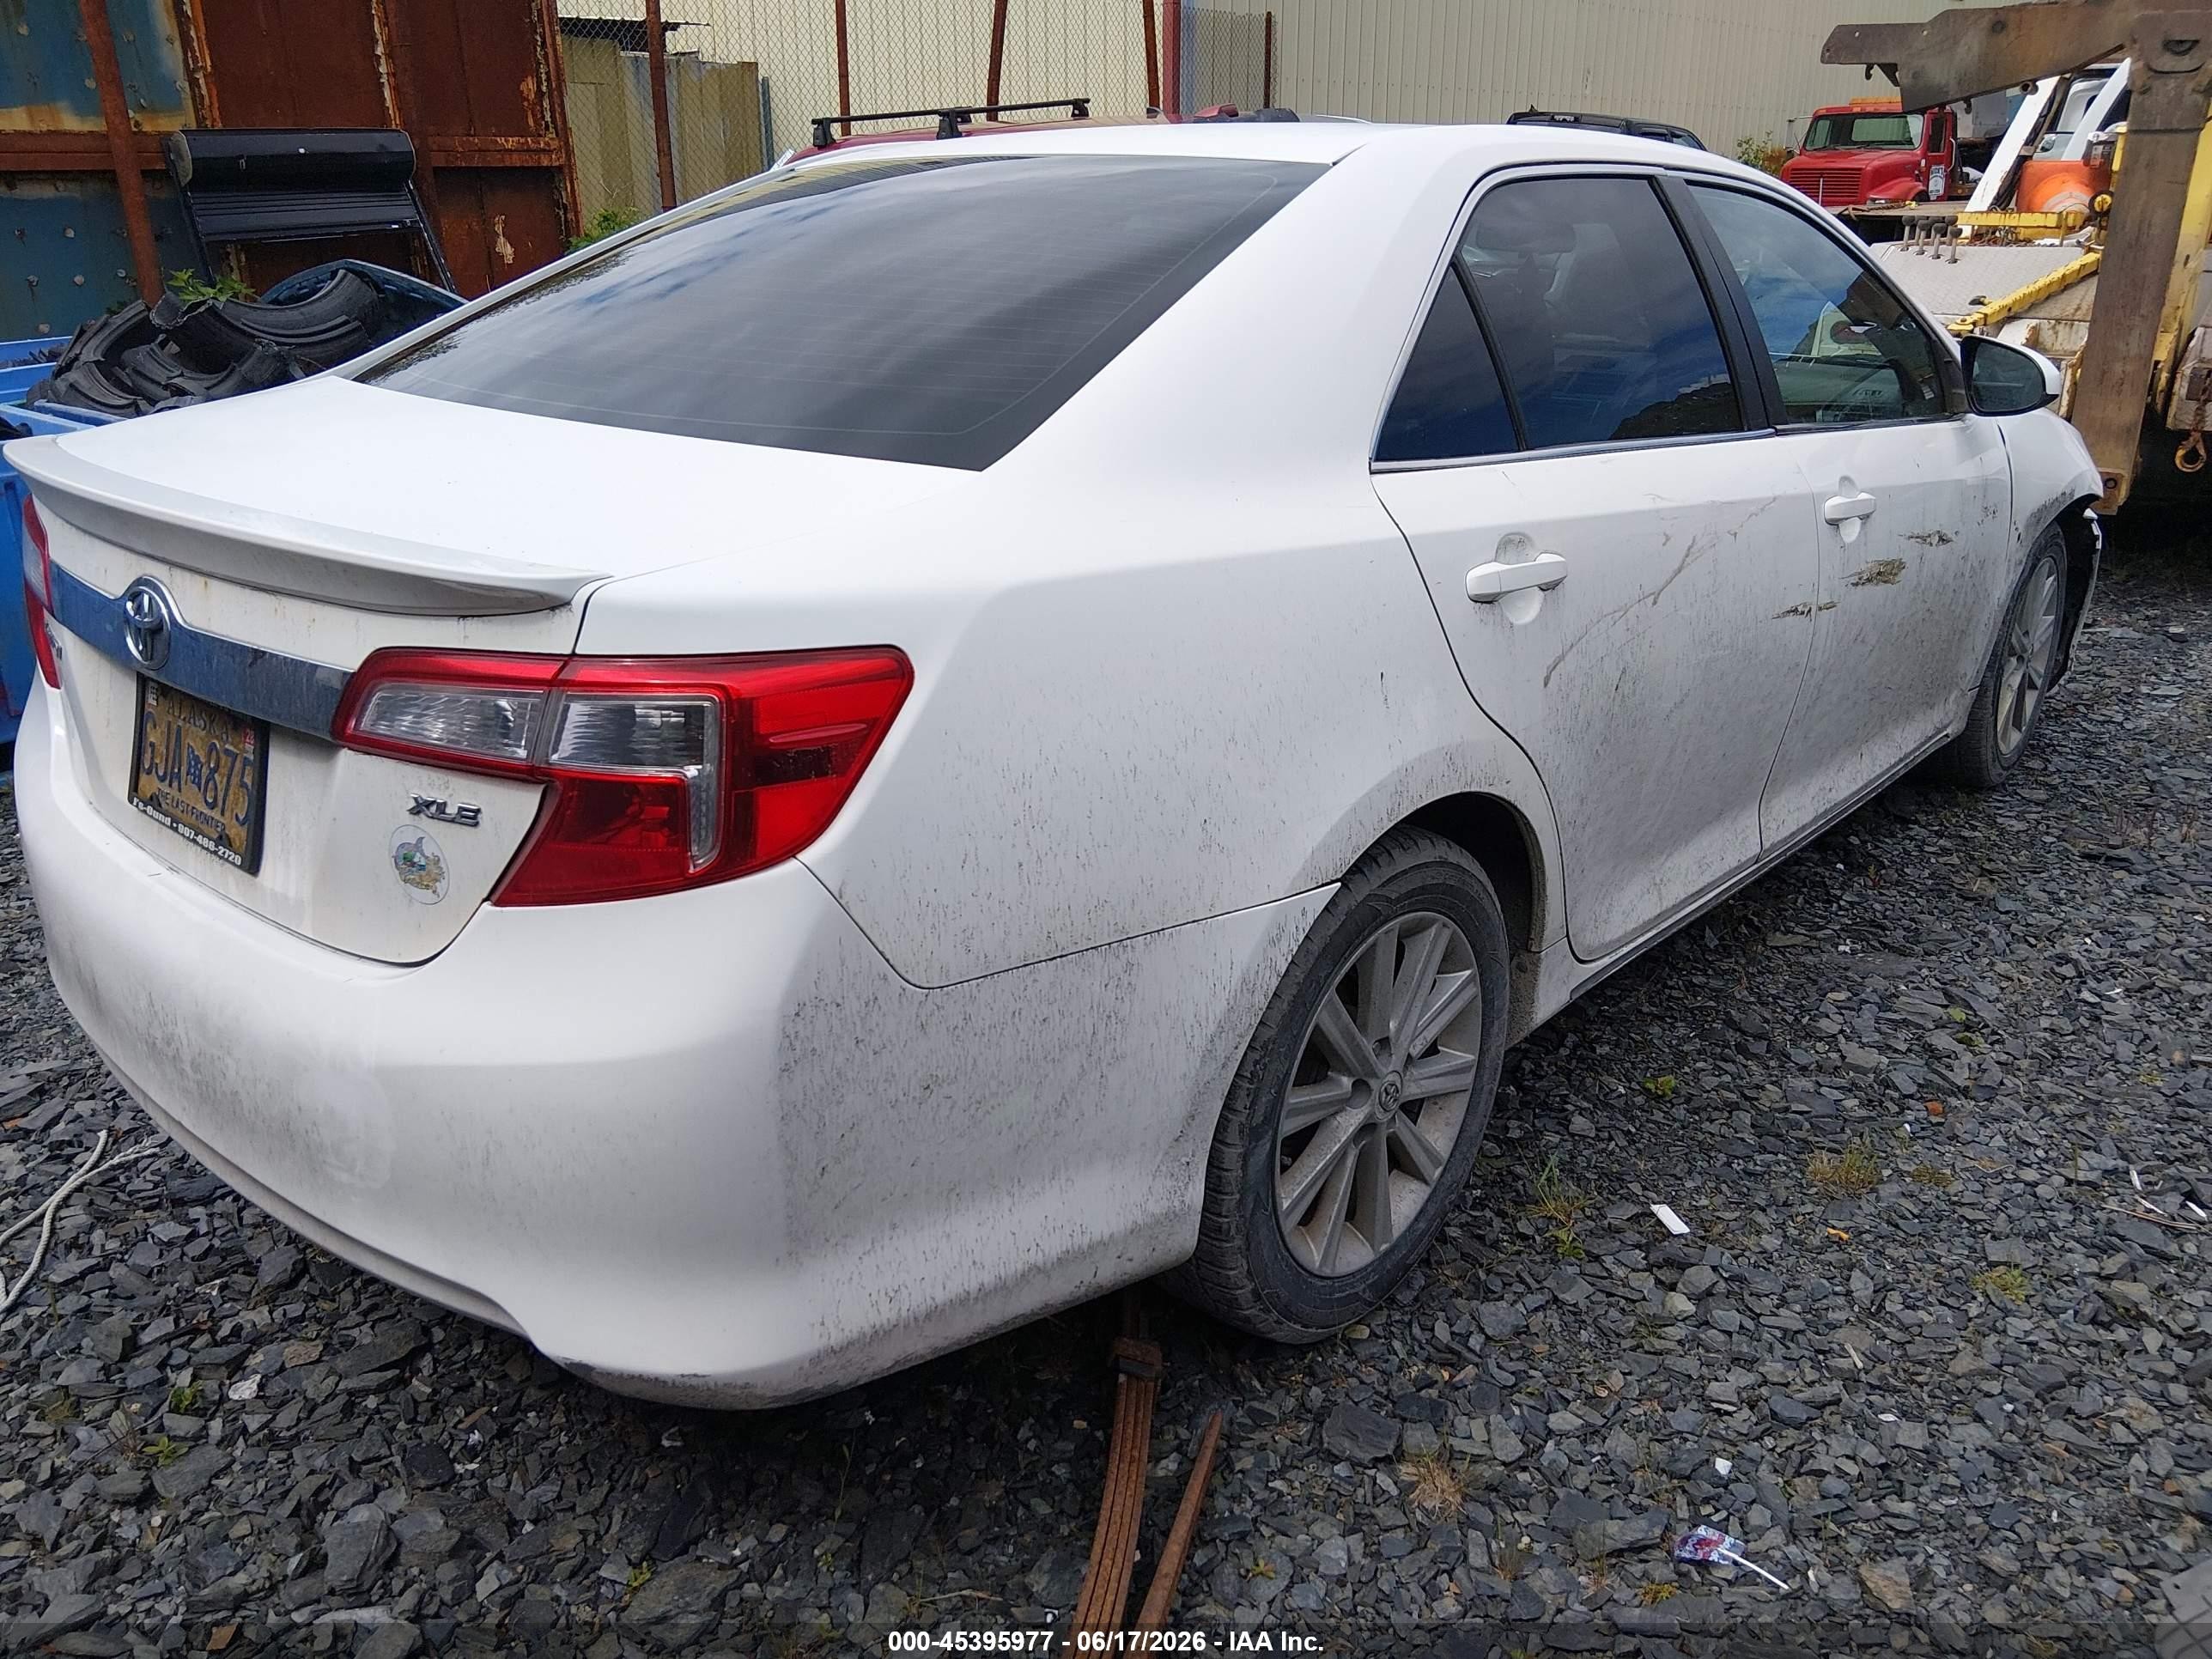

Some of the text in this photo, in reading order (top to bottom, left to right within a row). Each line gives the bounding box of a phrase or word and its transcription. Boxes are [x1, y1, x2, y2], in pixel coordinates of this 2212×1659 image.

[167, 700, 233, 743] ALASKA
[143, 709, 252, 826] GJA 875
[157, 787, 226, 833] THE LAST FRONTIER
[406, 793, 482, 827] XLE
